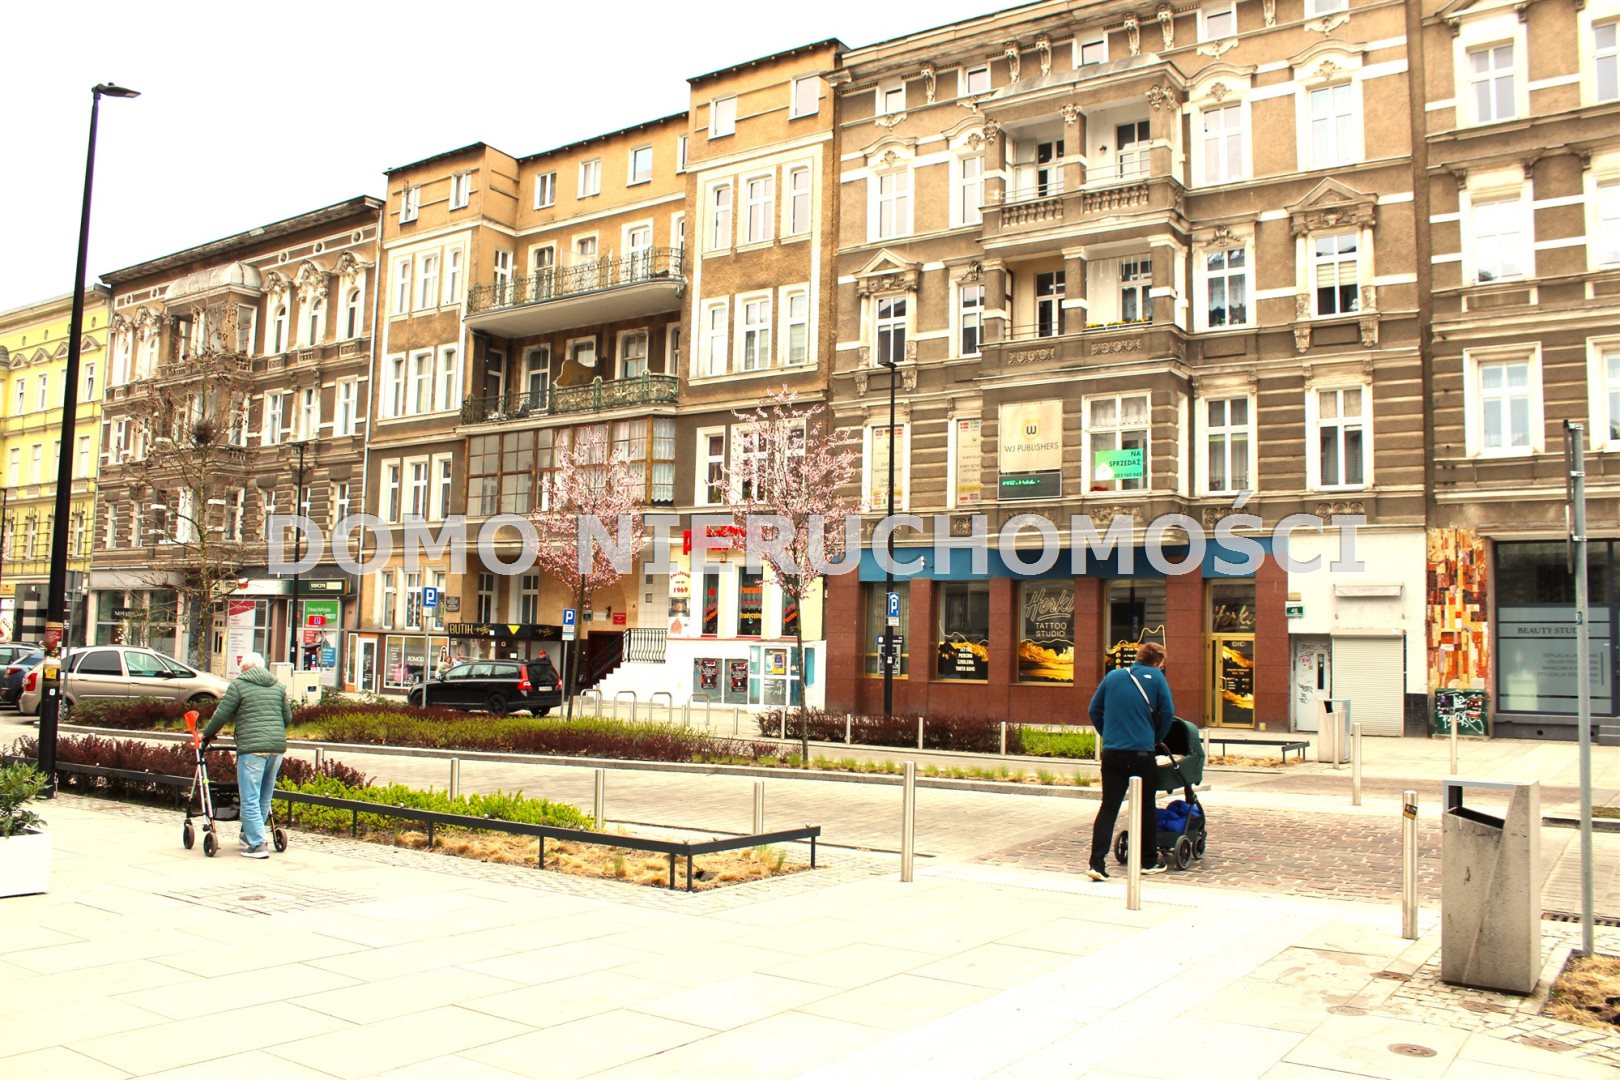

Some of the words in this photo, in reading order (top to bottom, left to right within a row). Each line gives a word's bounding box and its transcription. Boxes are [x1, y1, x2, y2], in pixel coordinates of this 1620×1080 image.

[1004, 445, 1016, 453] WJ
[1017, 441, 1059, 452] PUBLISHERS
[1108, 457, 1141, 468] SPRZEDAŻ
[1024, 587, 1075, 622] Herki
[565, 610, 574, 623] P
[449, 623, 474, 635] BUTIK
[1035, 622, 1067, 630] TATTOO
[1035, 630, 1066, 638] STUDIO
